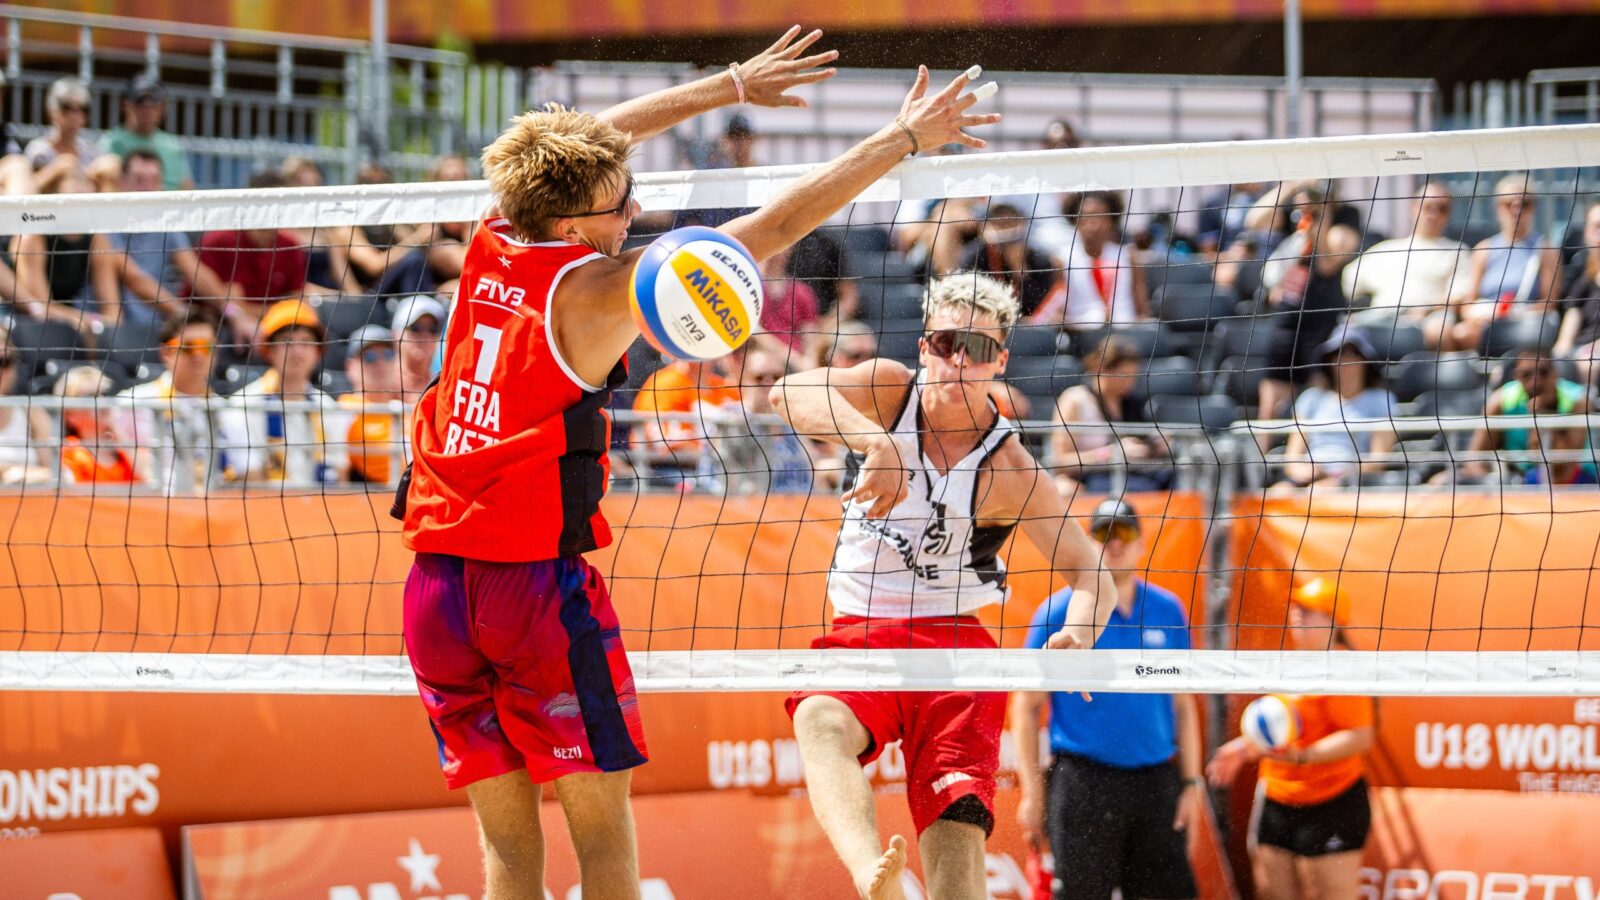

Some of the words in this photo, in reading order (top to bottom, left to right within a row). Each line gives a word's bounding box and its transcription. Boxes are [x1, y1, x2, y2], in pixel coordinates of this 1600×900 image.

[711, 249, 752, 288] BEACH
[473, 323, 503, 385] 1
[453, 379, 500, 432] FRA
[443, 422, 501, 455] BEZ
[1146, 666, 1180, 675] Senoh
[707, 739, 773, 788] U18
[1415, 723, 1491, 769] U18
[1496, 723, 1600, 770] WORL
[0, 763, 160, 822] ONSHIPS
